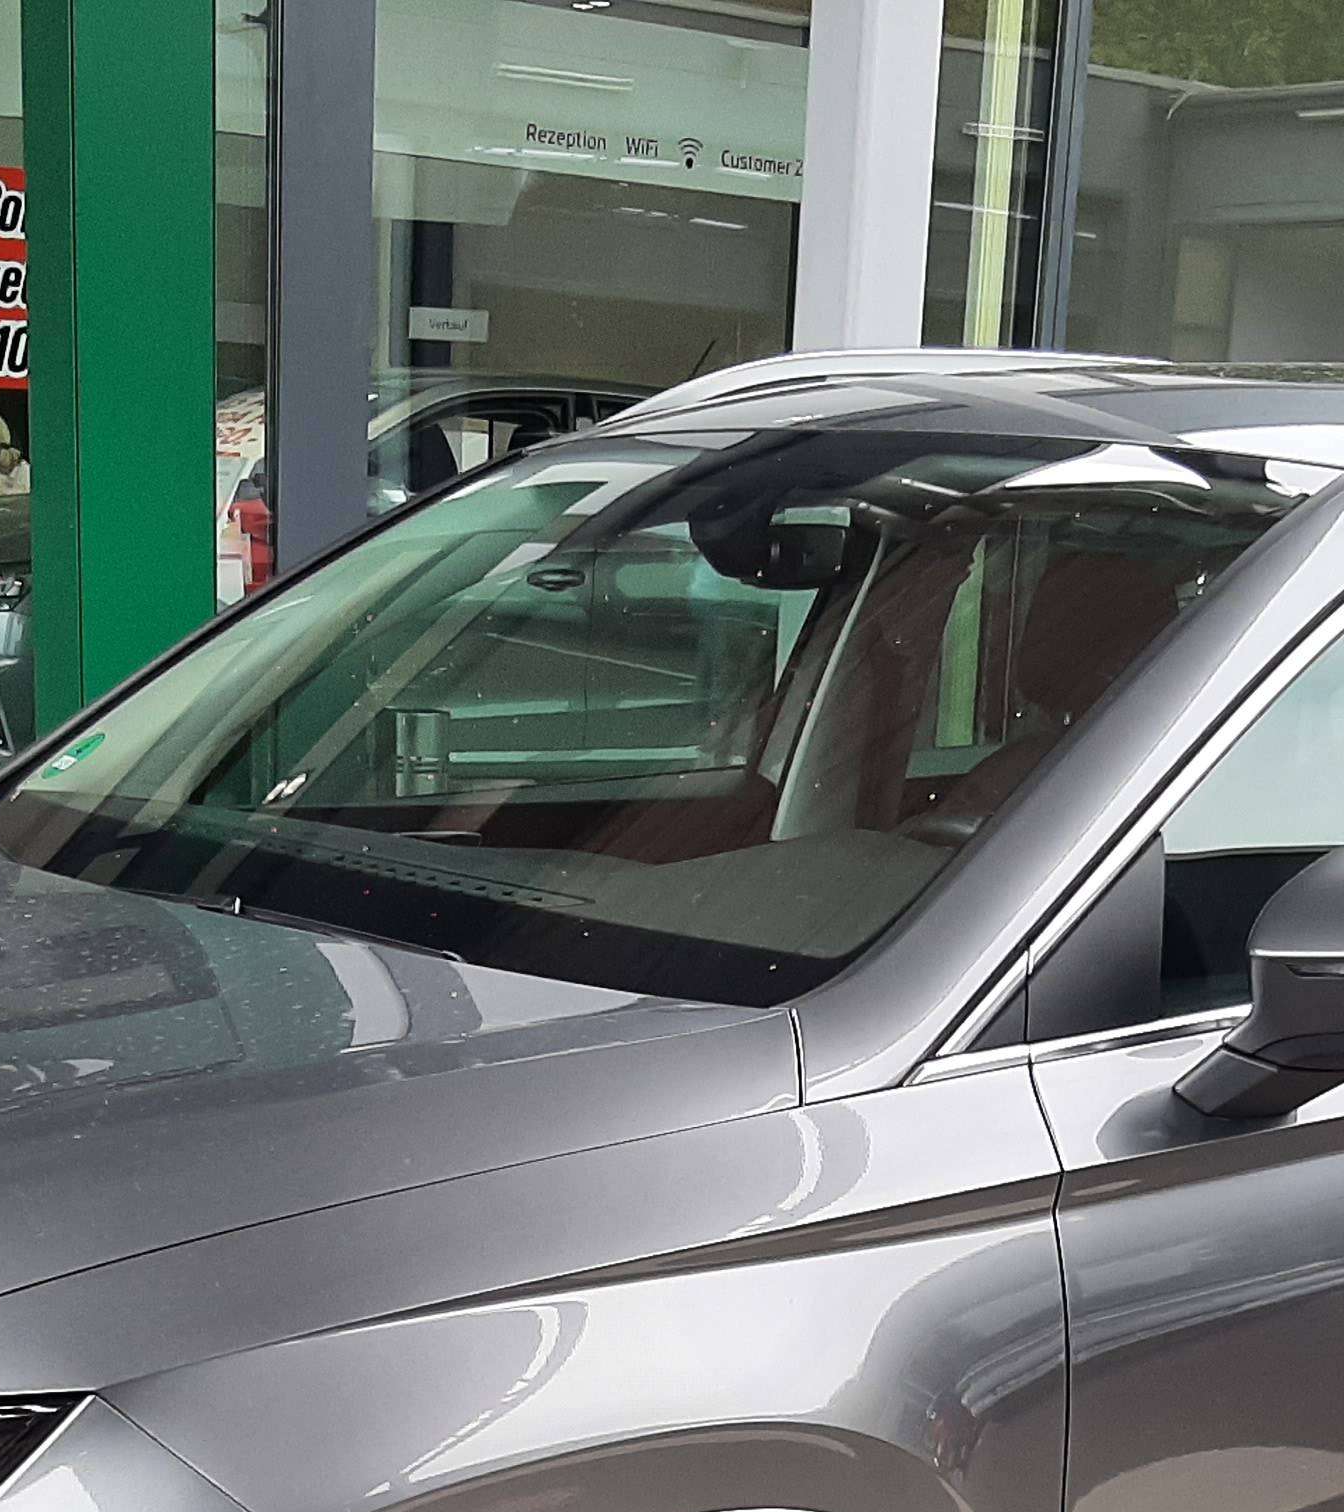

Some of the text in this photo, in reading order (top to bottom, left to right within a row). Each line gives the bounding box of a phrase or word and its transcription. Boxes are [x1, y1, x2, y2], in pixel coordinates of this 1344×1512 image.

[525, 122, 607, 151] Rezeption
[626, 136, 659, 158] WiFi
[720, 149, 793, 176] Customer
